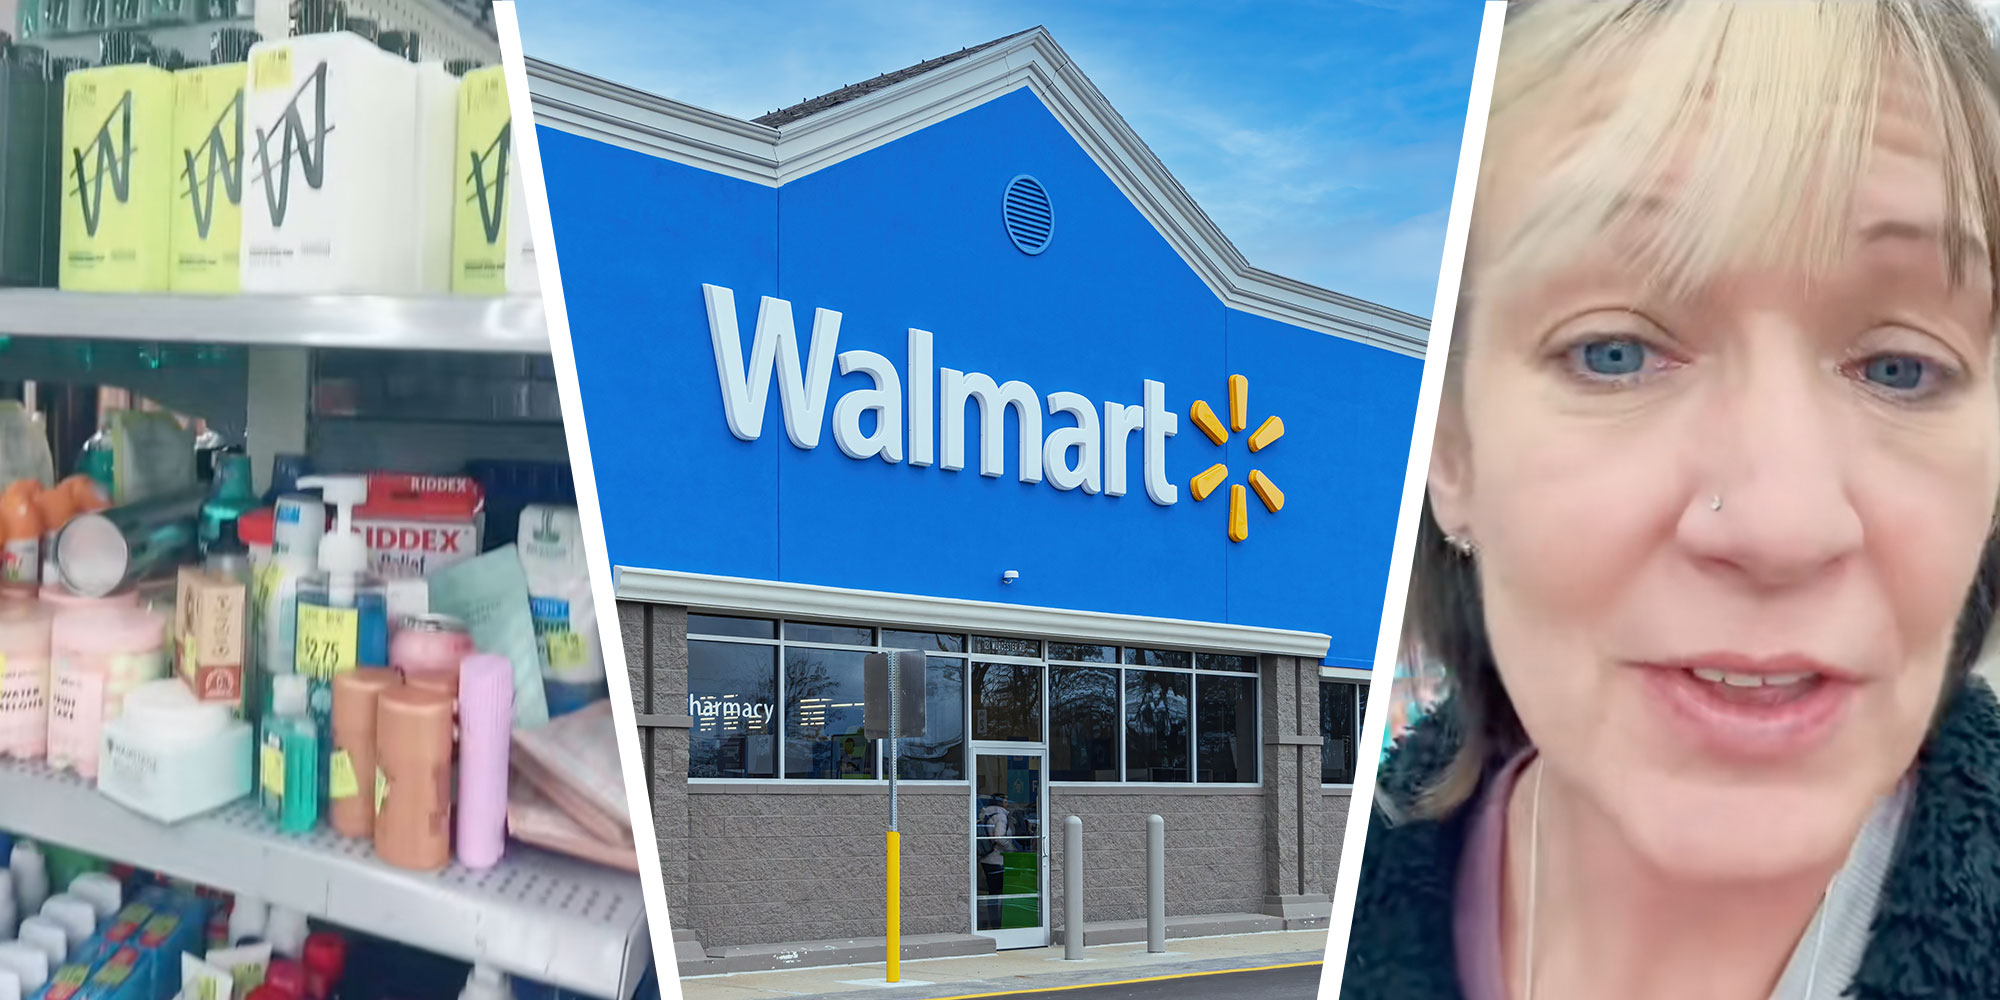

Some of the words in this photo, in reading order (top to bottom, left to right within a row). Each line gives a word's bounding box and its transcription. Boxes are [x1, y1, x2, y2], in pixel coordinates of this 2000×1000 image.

[702, 282, 1178, 506] Walmart
[410, 475, 467, 494] RIDDEX
[350, 526, 461, 554] IDDEX
